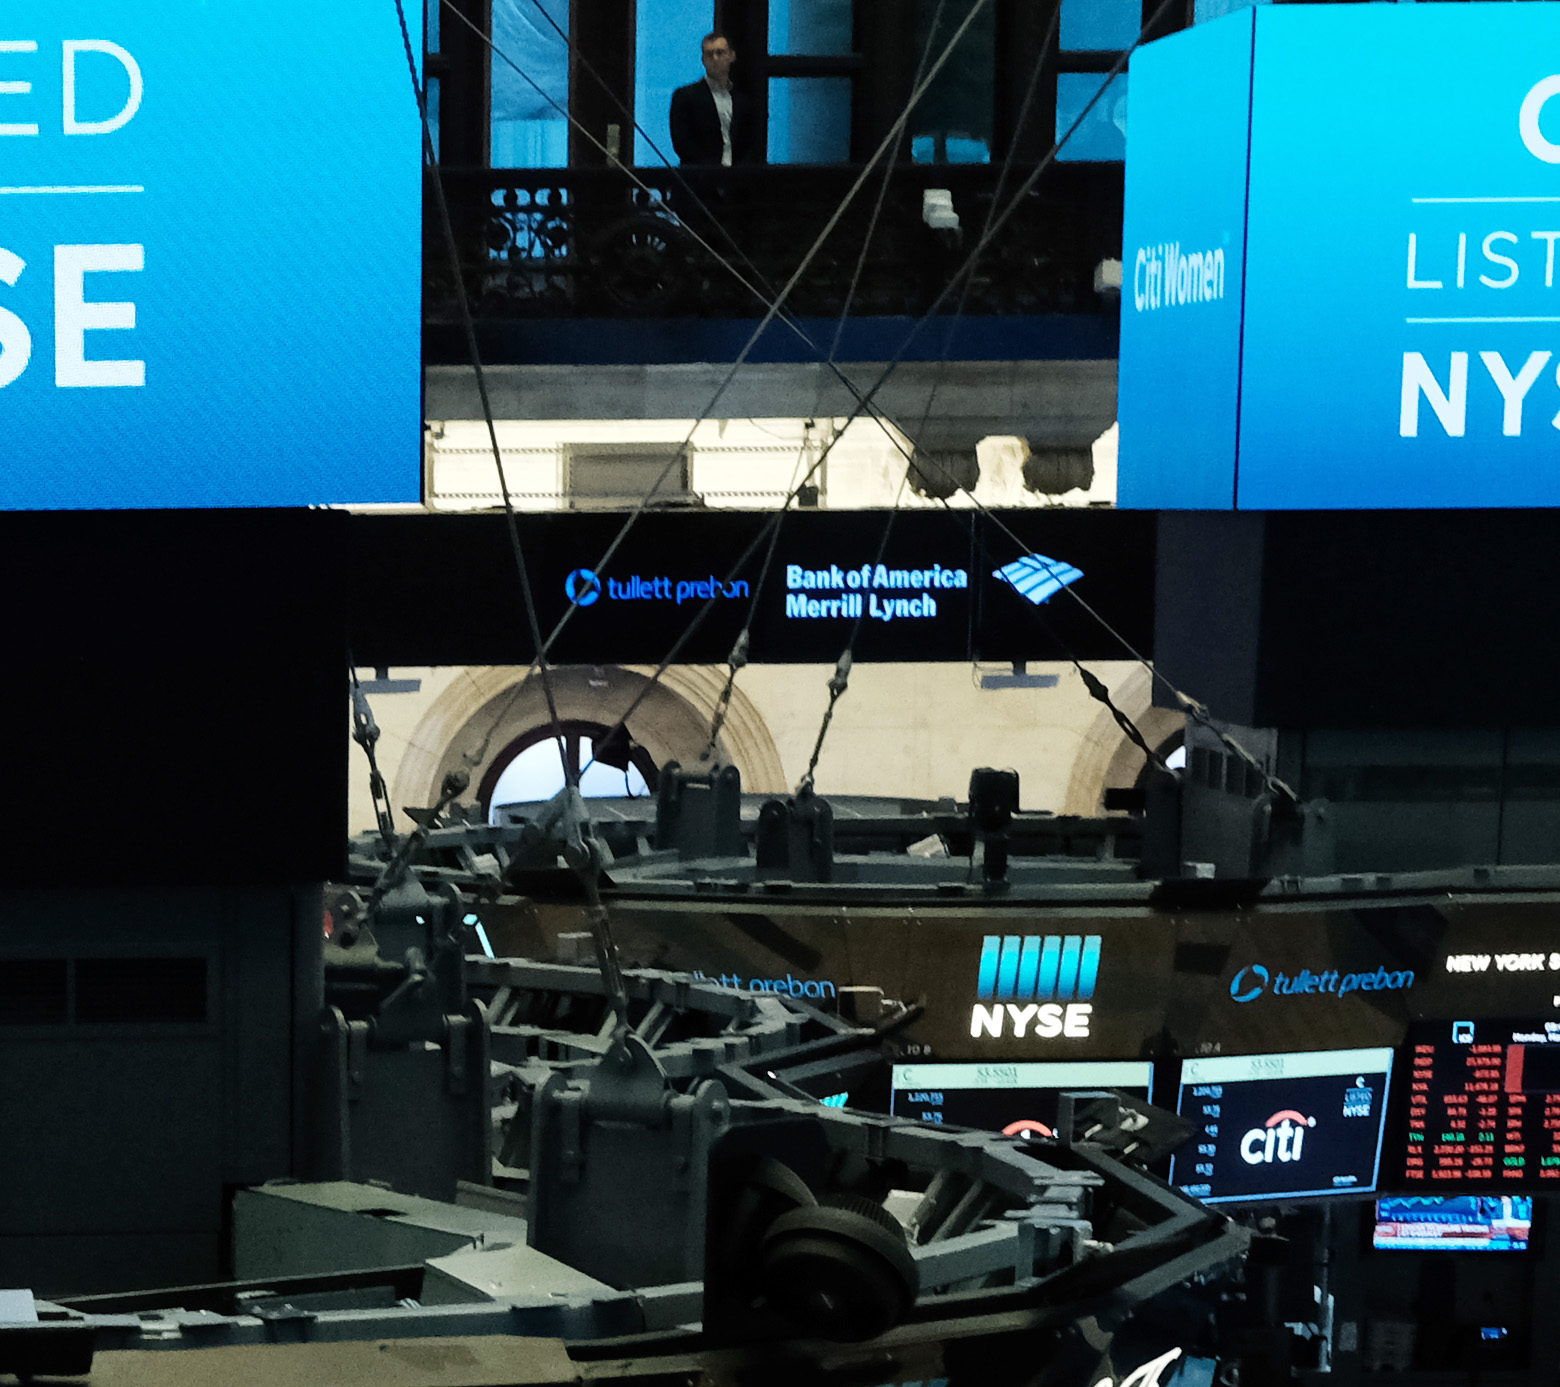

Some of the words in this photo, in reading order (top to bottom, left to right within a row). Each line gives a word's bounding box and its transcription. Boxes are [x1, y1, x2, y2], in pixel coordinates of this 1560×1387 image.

[1134, 247, 1162, 311] Citi
[1164, 243, 1224, 308] Women
[607, 574, 672, 601] tullett
[675, 574, 749, 604] prebon
[786, 565, 844, 590] Bank
[848, 565, 872, 590] of
[872, 565, 967, 590] America
[786, 593, 863, 618] Merrill
[869, 593, 937, 621] Lynch
[1446, 955, 1491, 973] NEW
[1495, 954, 1545, 971] YORK
[1274, 969, 1339, 995] tullett
[1339, 966, 1414, 998] prebon
[970, 1003, 1093, 1038] NYSE
